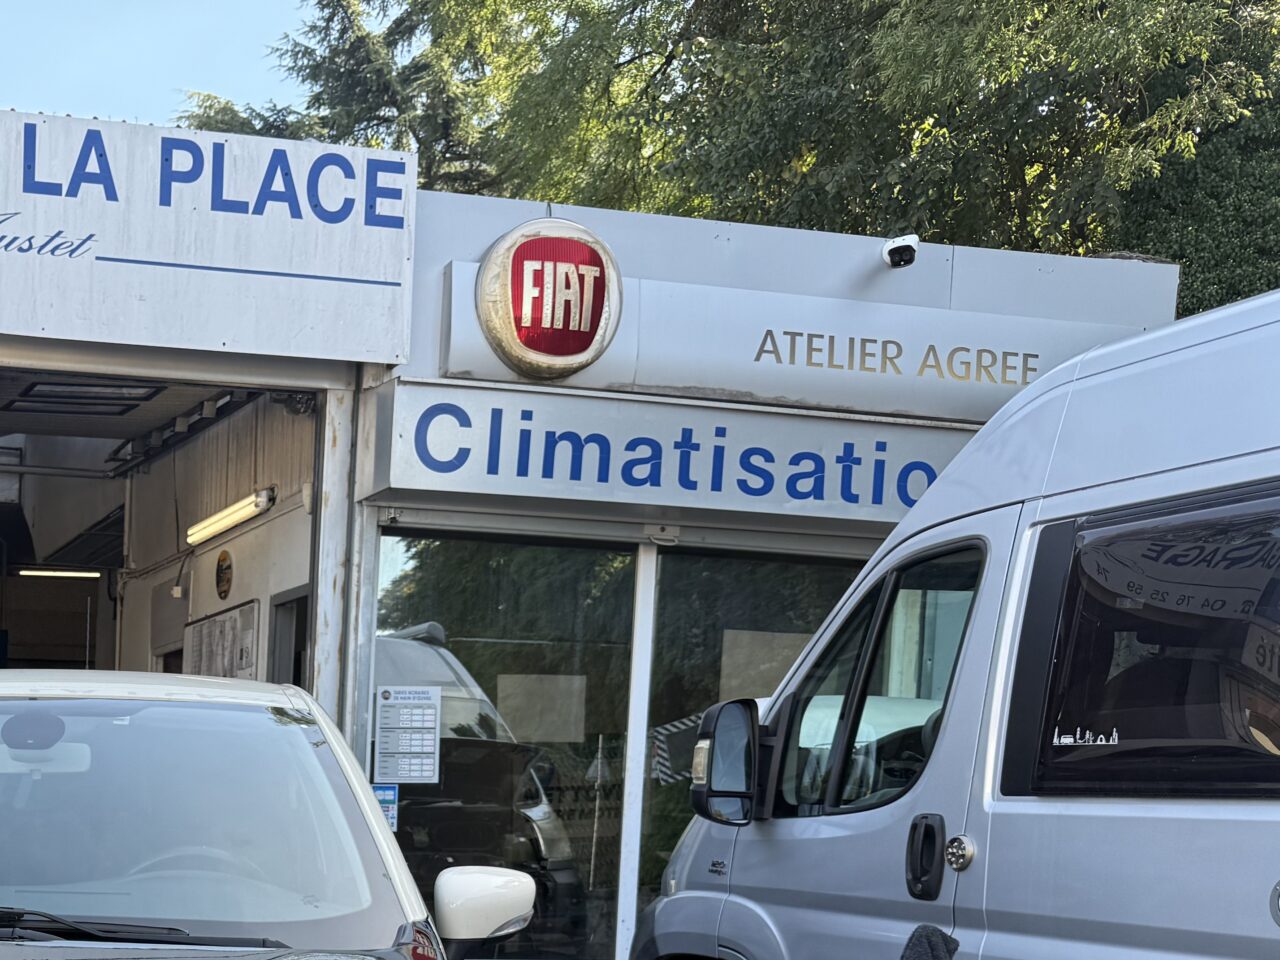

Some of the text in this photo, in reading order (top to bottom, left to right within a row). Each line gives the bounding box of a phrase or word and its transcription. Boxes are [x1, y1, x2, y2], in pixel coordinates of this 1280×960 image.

[22, 122, 120, 202] LA
[159, 136, 406, 229] PLACE
[521, 260, 600, 332] FIAT
[753, 329, 903, 375] ATELIER
